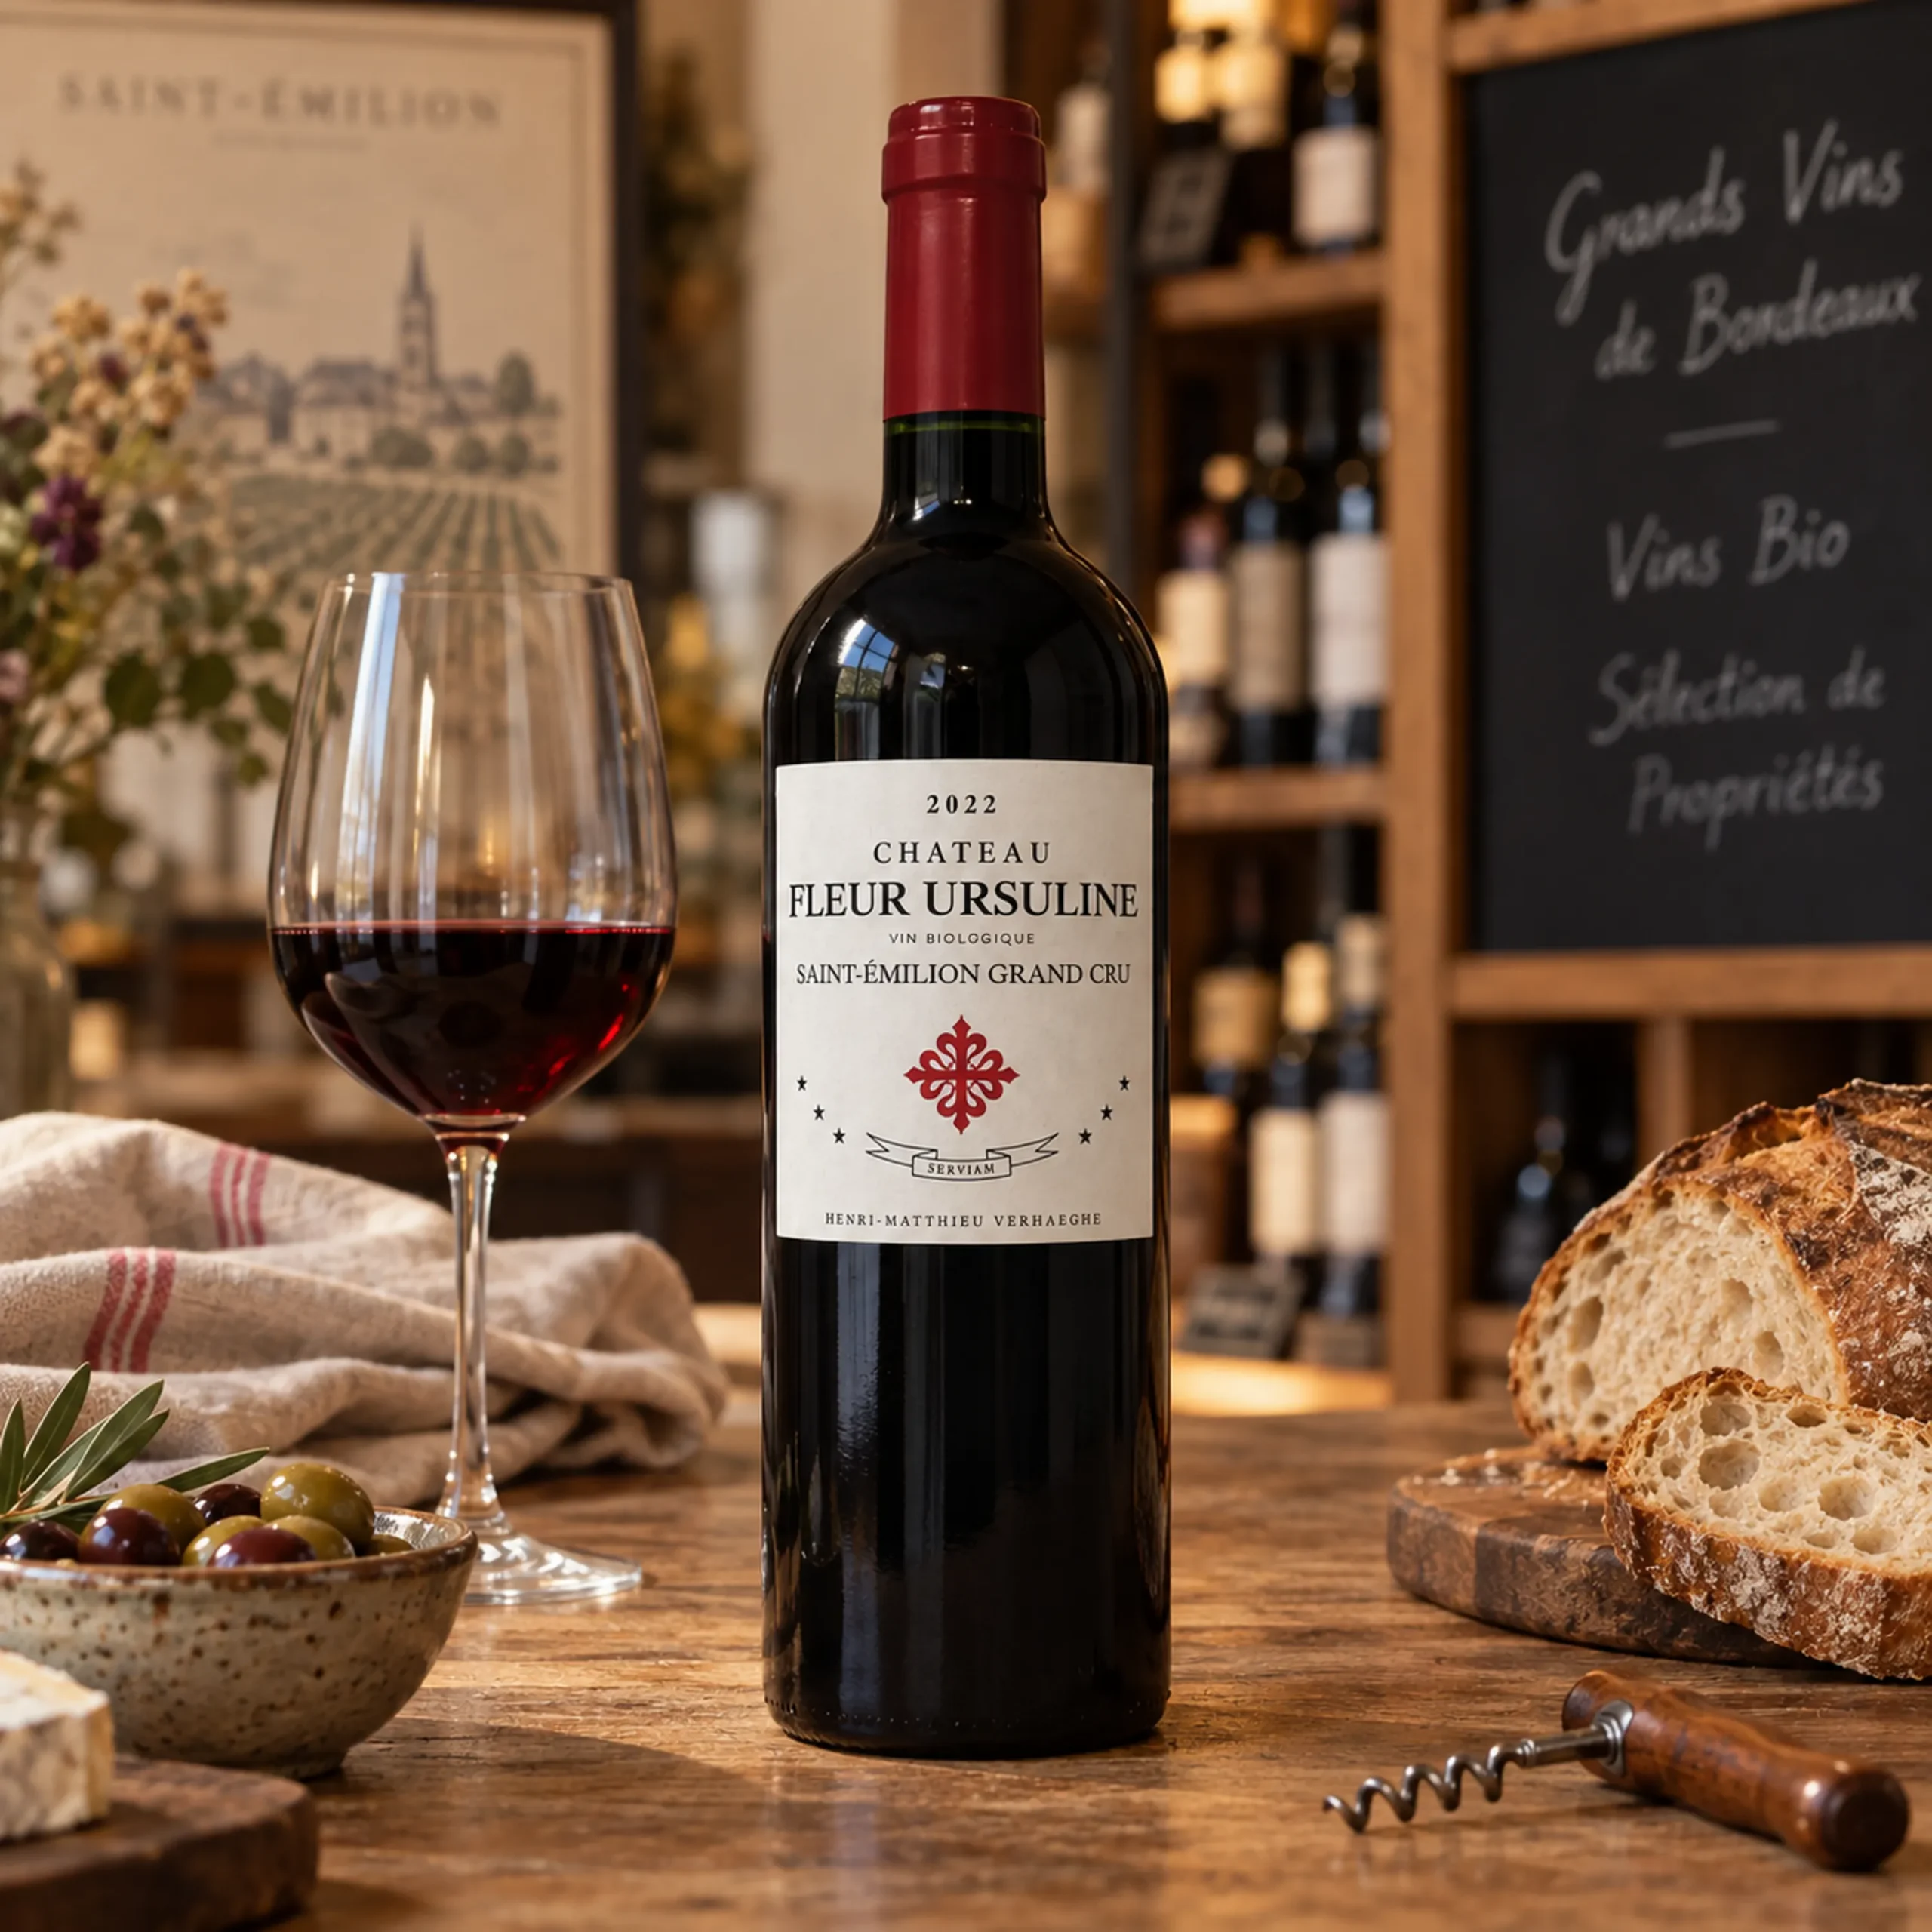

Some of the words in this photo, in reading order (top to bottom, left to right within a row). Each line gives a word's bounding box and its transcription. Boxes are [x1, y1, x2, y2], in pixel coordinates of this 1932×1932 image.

[1545, 145, 1746, 328] Grands
[1782, 119, 1903, 224] Vins
[1594, 300, 1657, 380] de
[1678, 258, 1921, 377] Bordeaux
[1606, 513, 1722, 601] Vins
[1748, 494, 1851, 586] Bio
[1827, 645, 1885, 711] de
[927, 794, 996, 814] 2022
[873, 841, 1050, 864] CHATEAU
[789, 881, 911, 918] FLEUR
[923, 880, 1139, 918] URSULINE
[889, 933, 917, 944] VIN
[926, 932, 1035, 947] BIOLOGIQUE
[796, 959, 980, 985] SAINT-ÉMILION
[988, 963, 1084, 984] GRAND
[1089, 964, 1131, 984] CRU
[927, 1162, 995, 1176] SERVIAM
[826, 1212, 983, 1228] HENRI-MATTHIEU
[994, 1212, 1101, 1227] VERHAEGHE
